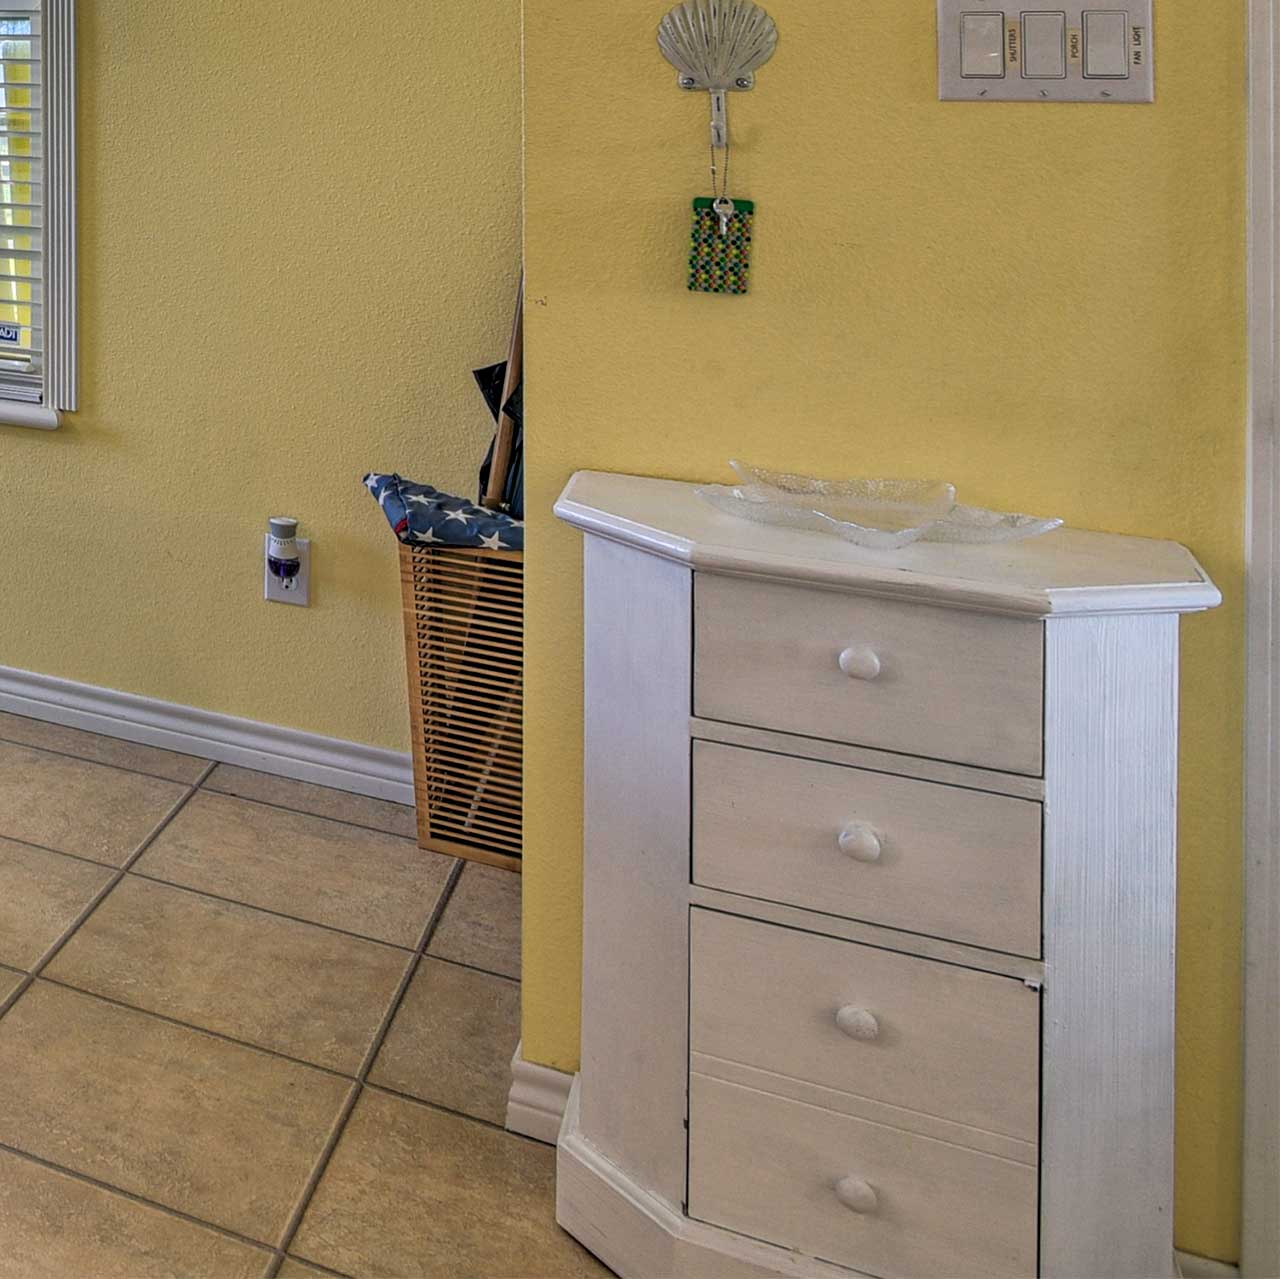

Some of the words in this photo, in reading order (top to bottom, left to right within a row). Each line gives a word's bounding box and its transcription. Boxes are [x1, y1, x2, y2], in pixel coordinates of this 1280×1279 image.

[1008, 28, 1018, 63] SHUTTERS
[1069, 34, 1080, 59] PORCH
[1132, 26, 1143, 47] LIGHT
[1133, 50, 1143, 65] FAN
